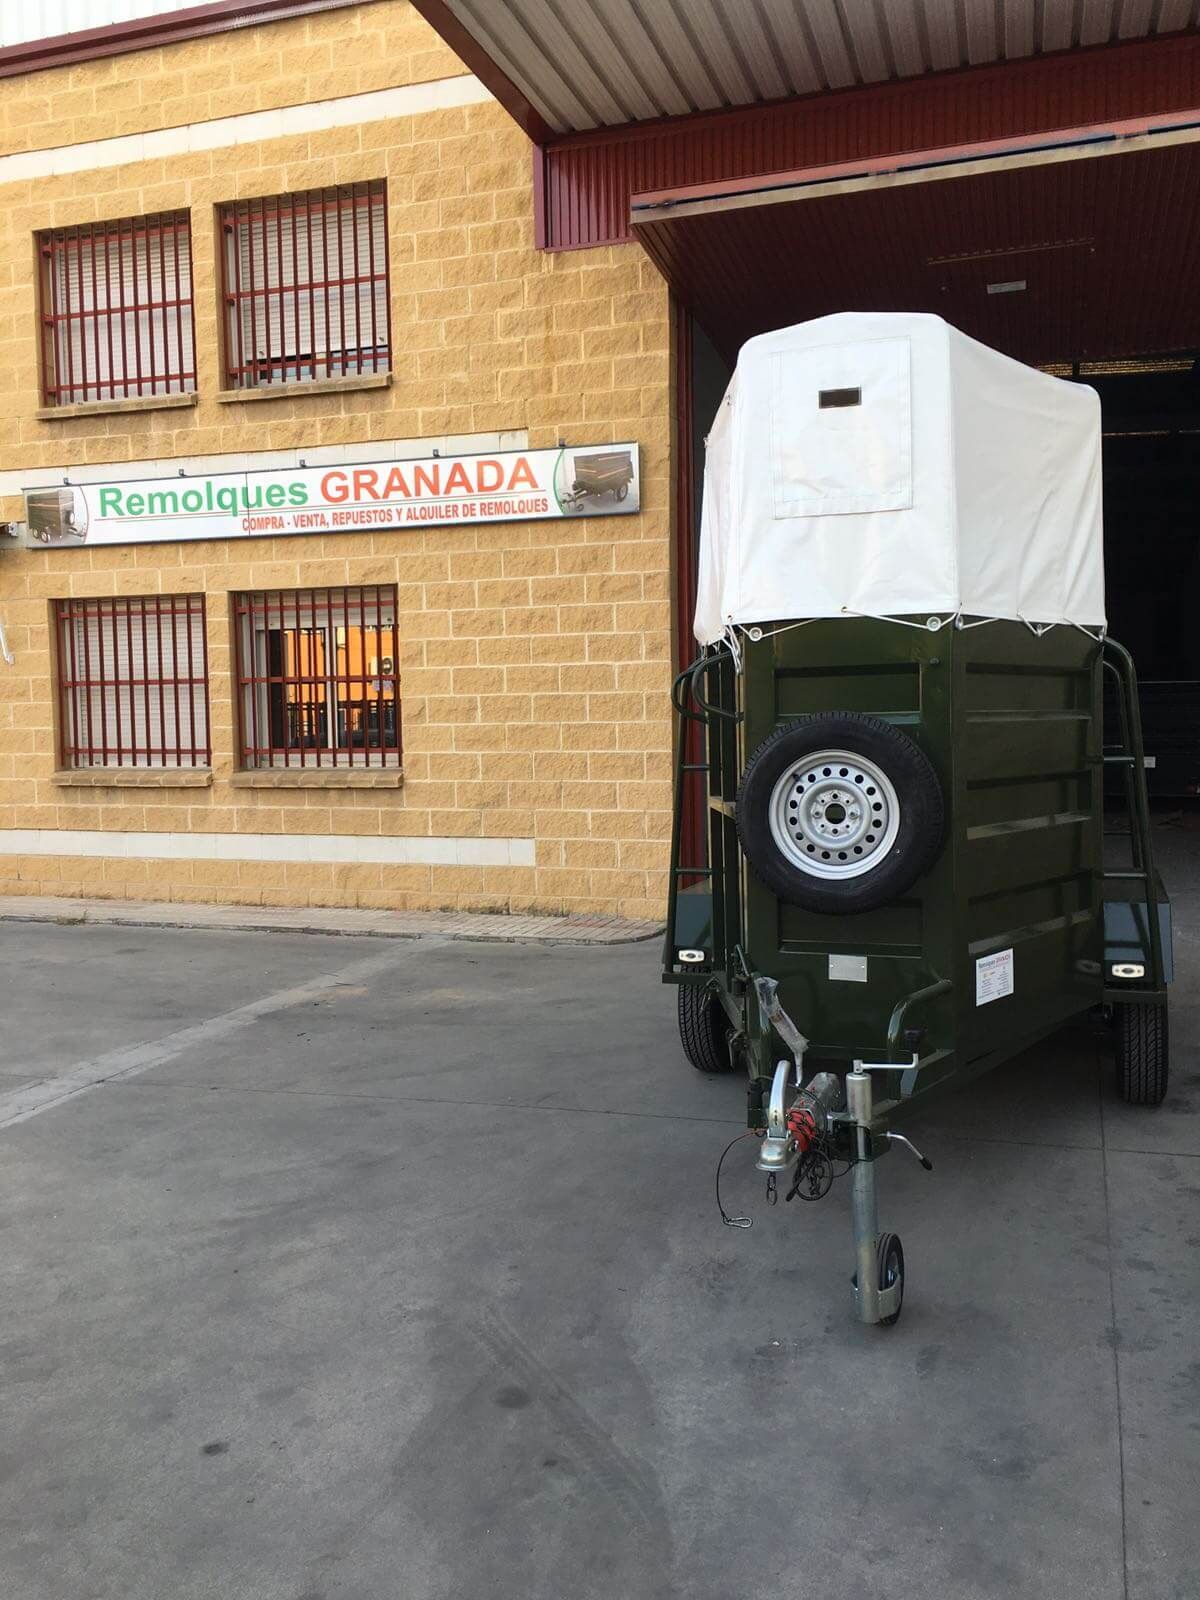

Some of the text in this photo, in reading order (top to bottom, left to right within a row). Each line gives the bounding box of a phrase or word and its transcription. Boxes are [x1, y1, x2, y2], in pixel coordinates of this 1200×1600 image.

[99, 457, 538, 517] Remolques GRANADA
[242, 515, 284, 531] COMPRA
[293, 512, 330, 529] VENTA,
[332, 508, 392, 526] REPUESTOS
[396, 508, 403, 522] Y
[406, 503, 459, 521] ALQUILER
[462, 503, 477, 518] DE
[480, 497, 549, 516] REMOLQUES
